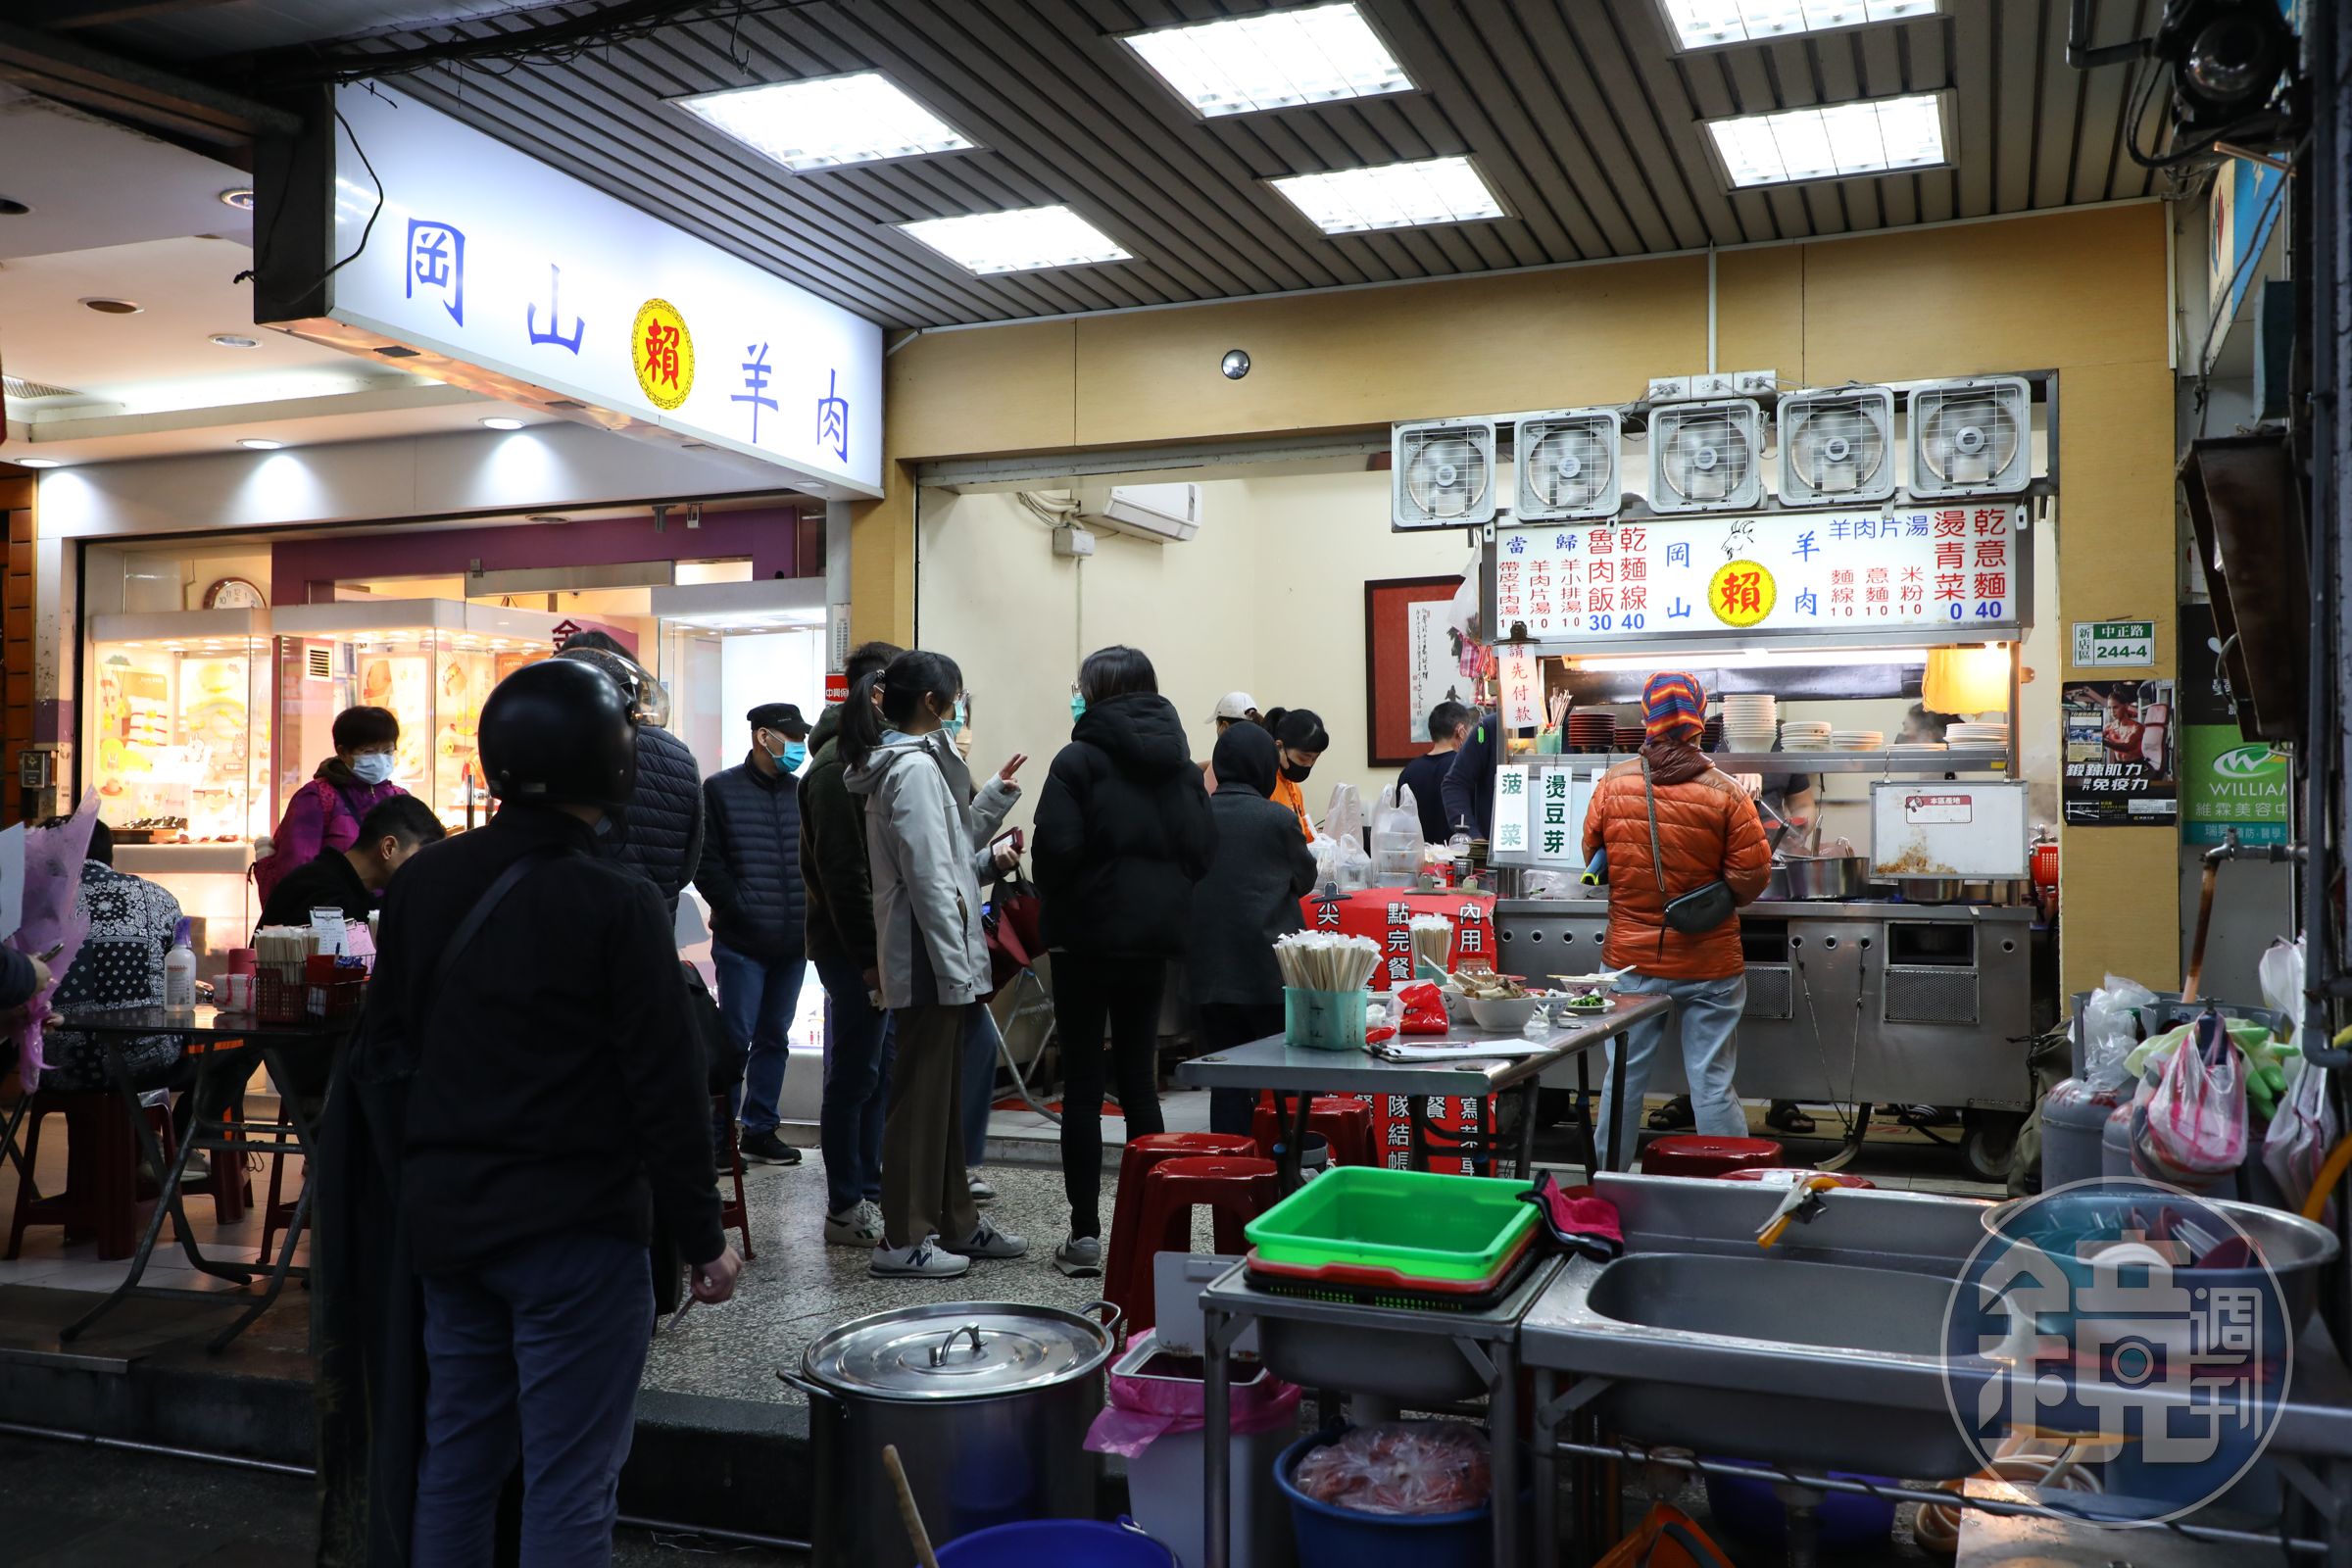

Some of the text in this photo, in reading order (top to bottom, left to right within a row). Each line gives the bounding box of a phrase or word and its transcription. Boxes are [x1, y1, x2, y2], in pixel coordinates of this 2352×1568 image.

[1829, 514, 1929, 540] 羊肉片湯
[1588, 529, 1614, 631] 魯肉飯 30
[1620, 526, 1647, 630] 乾麵線 40
[1667, 542, 1691, 618] 岡山
[1791, 530, 1820, 616] 羊肉
[1935, 510, 1966, 602] 燙青菜
[1974, 509, 2006, 618] 乾意麵 40
[1498, 561, 1520, 616] 帶皮羊肉湯
[1530, 560, 1550, 614] 羊肉片湯
[1560, 559, 1582, 613] 羊小排湯
[1720, 571, 1760, 614] 賴
[1831, 569, 1854, 604] 麵線
[1866, 567, 1889, 603] 意麵
[1900, 565, 1924, 602] 米粉
[2079, 627, 2090, 661] 新店區
[2096, 645, 2147, 659] 244-4
[2101, 624, 2144, 638] 中正路
[1507, 643, 1533, 722] 請先付款
[1544, 775, 1566, 854] 燙豆芽
[1387, 903, 1410, 980] 點完餐
